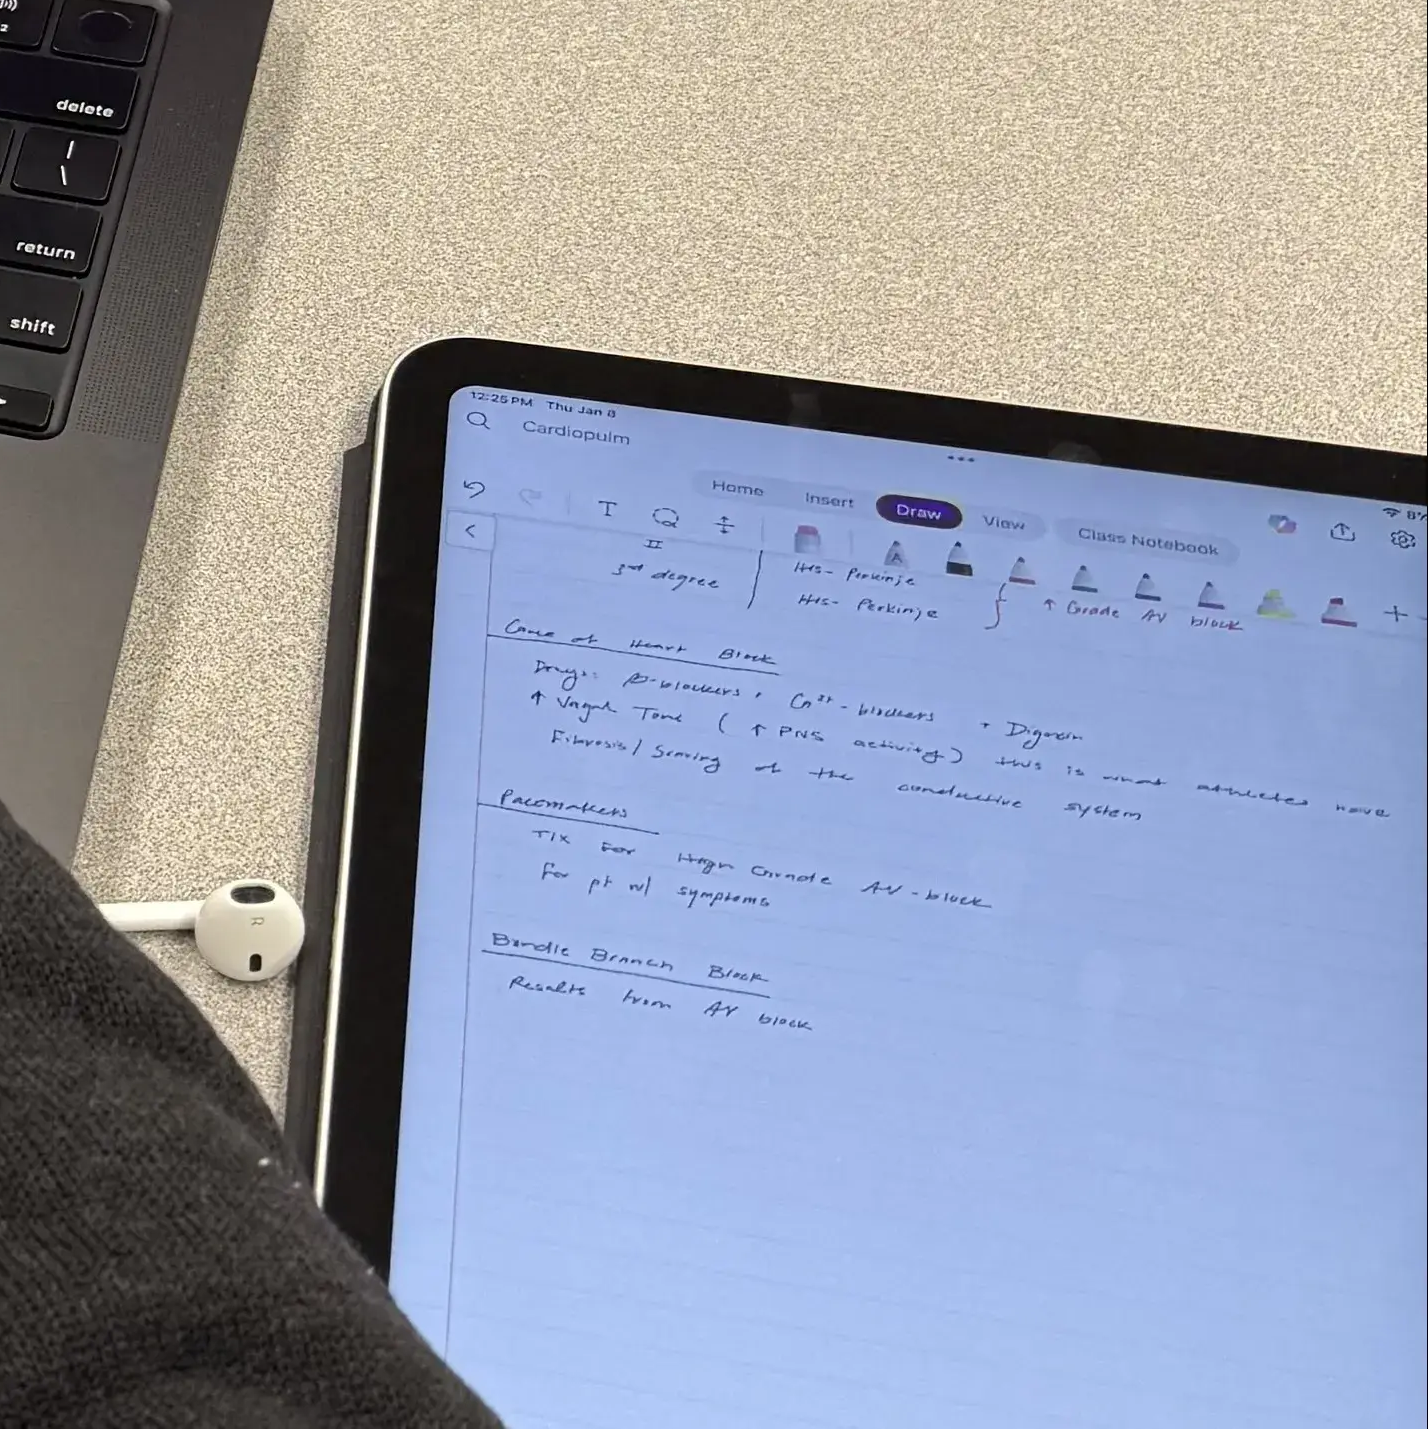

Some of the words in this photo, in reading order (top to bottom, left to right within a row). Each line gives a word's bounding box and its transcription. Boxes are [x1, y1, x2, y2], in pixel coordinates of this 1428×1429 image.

[56, 99, 114, 118] delete
[17, 242, 75, 260] return
[10, 318, 55, 336] shift
[522, 420, 630, 444] Cardiopulm
[712, 480, 764, 496] Home
[805, 492, 854, 508] Insert
[896, 503, 941, 519] Draw
[982, 515, 1025, 530] View
[1078, 527, 1126, 543] Class
[1131, 534, 1218, 555] Notebook
